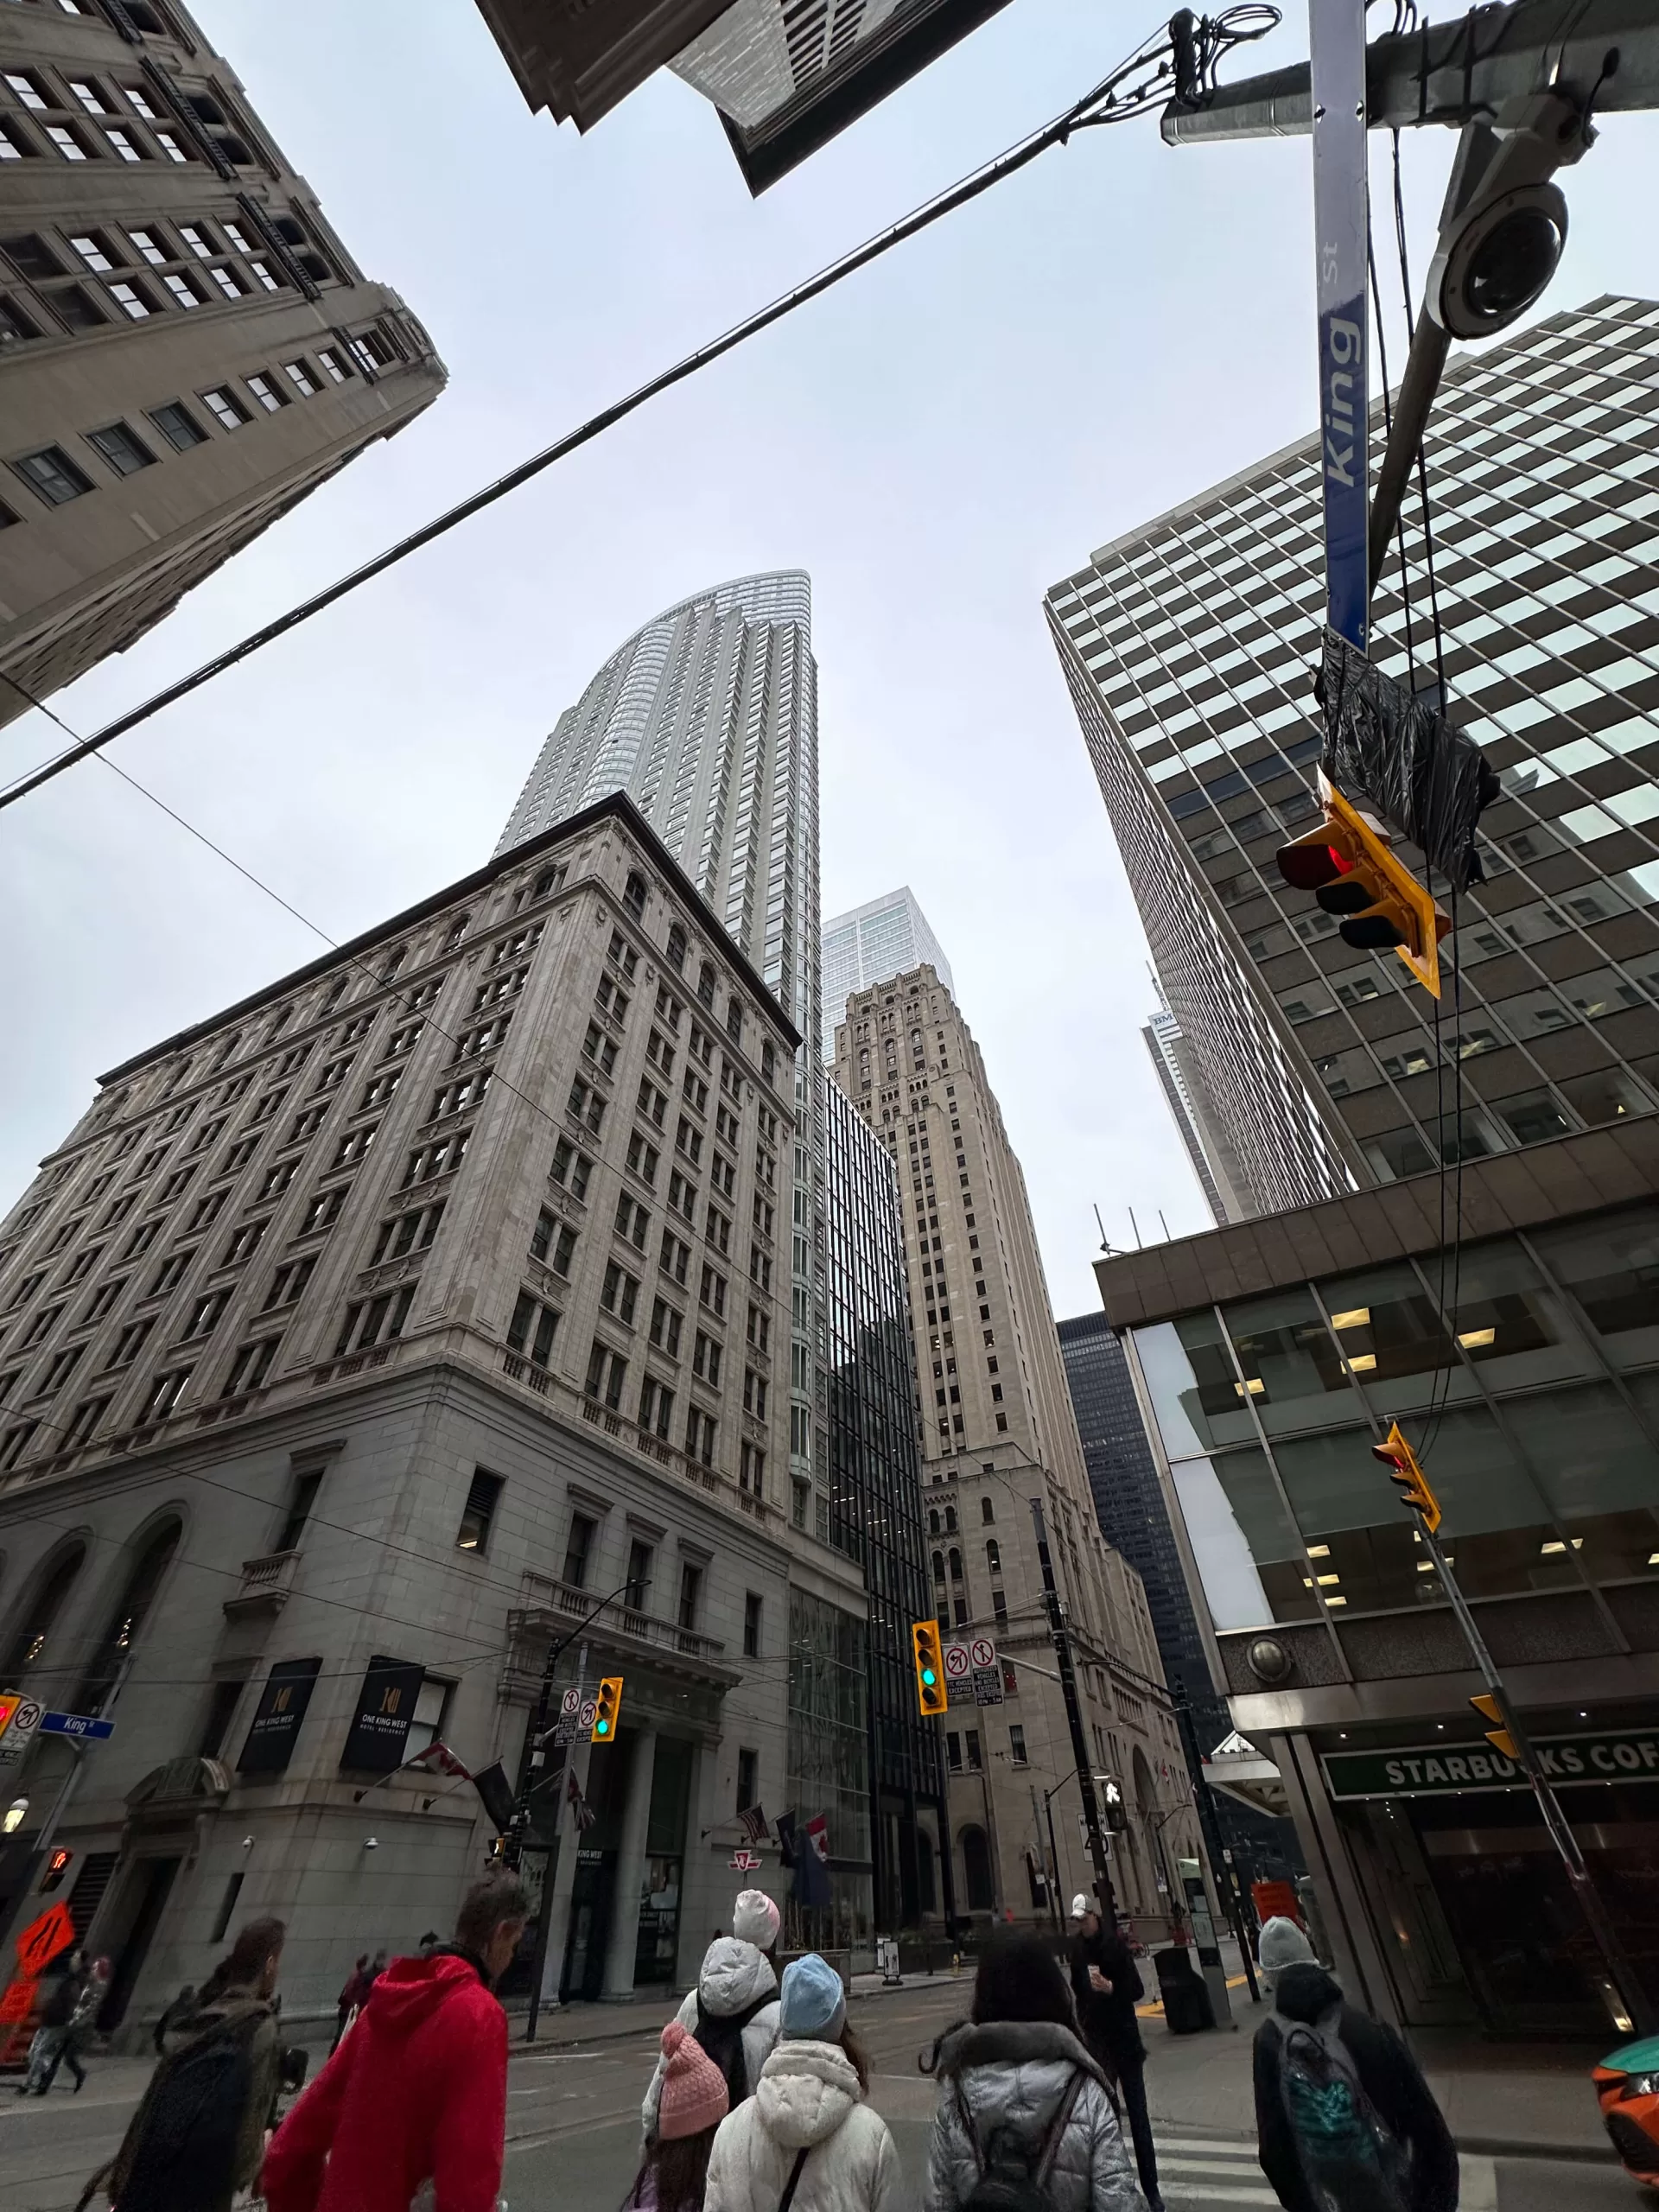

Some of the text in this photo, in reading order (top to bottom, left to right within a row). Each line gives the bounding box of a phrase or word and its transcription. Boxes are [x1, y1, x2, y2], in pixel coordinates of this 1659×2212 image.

[1323, 242, 1362, 487] King St
[948, 1686, 972, 1694] EXCEPTED
[63, 1717, 87, 1734] King
[266, 1716, 281, 1726] KING
[362, 1714, 408, 1729] ONE KING WEST
[1384, 1747, 1585, 1785] STARBUKS
